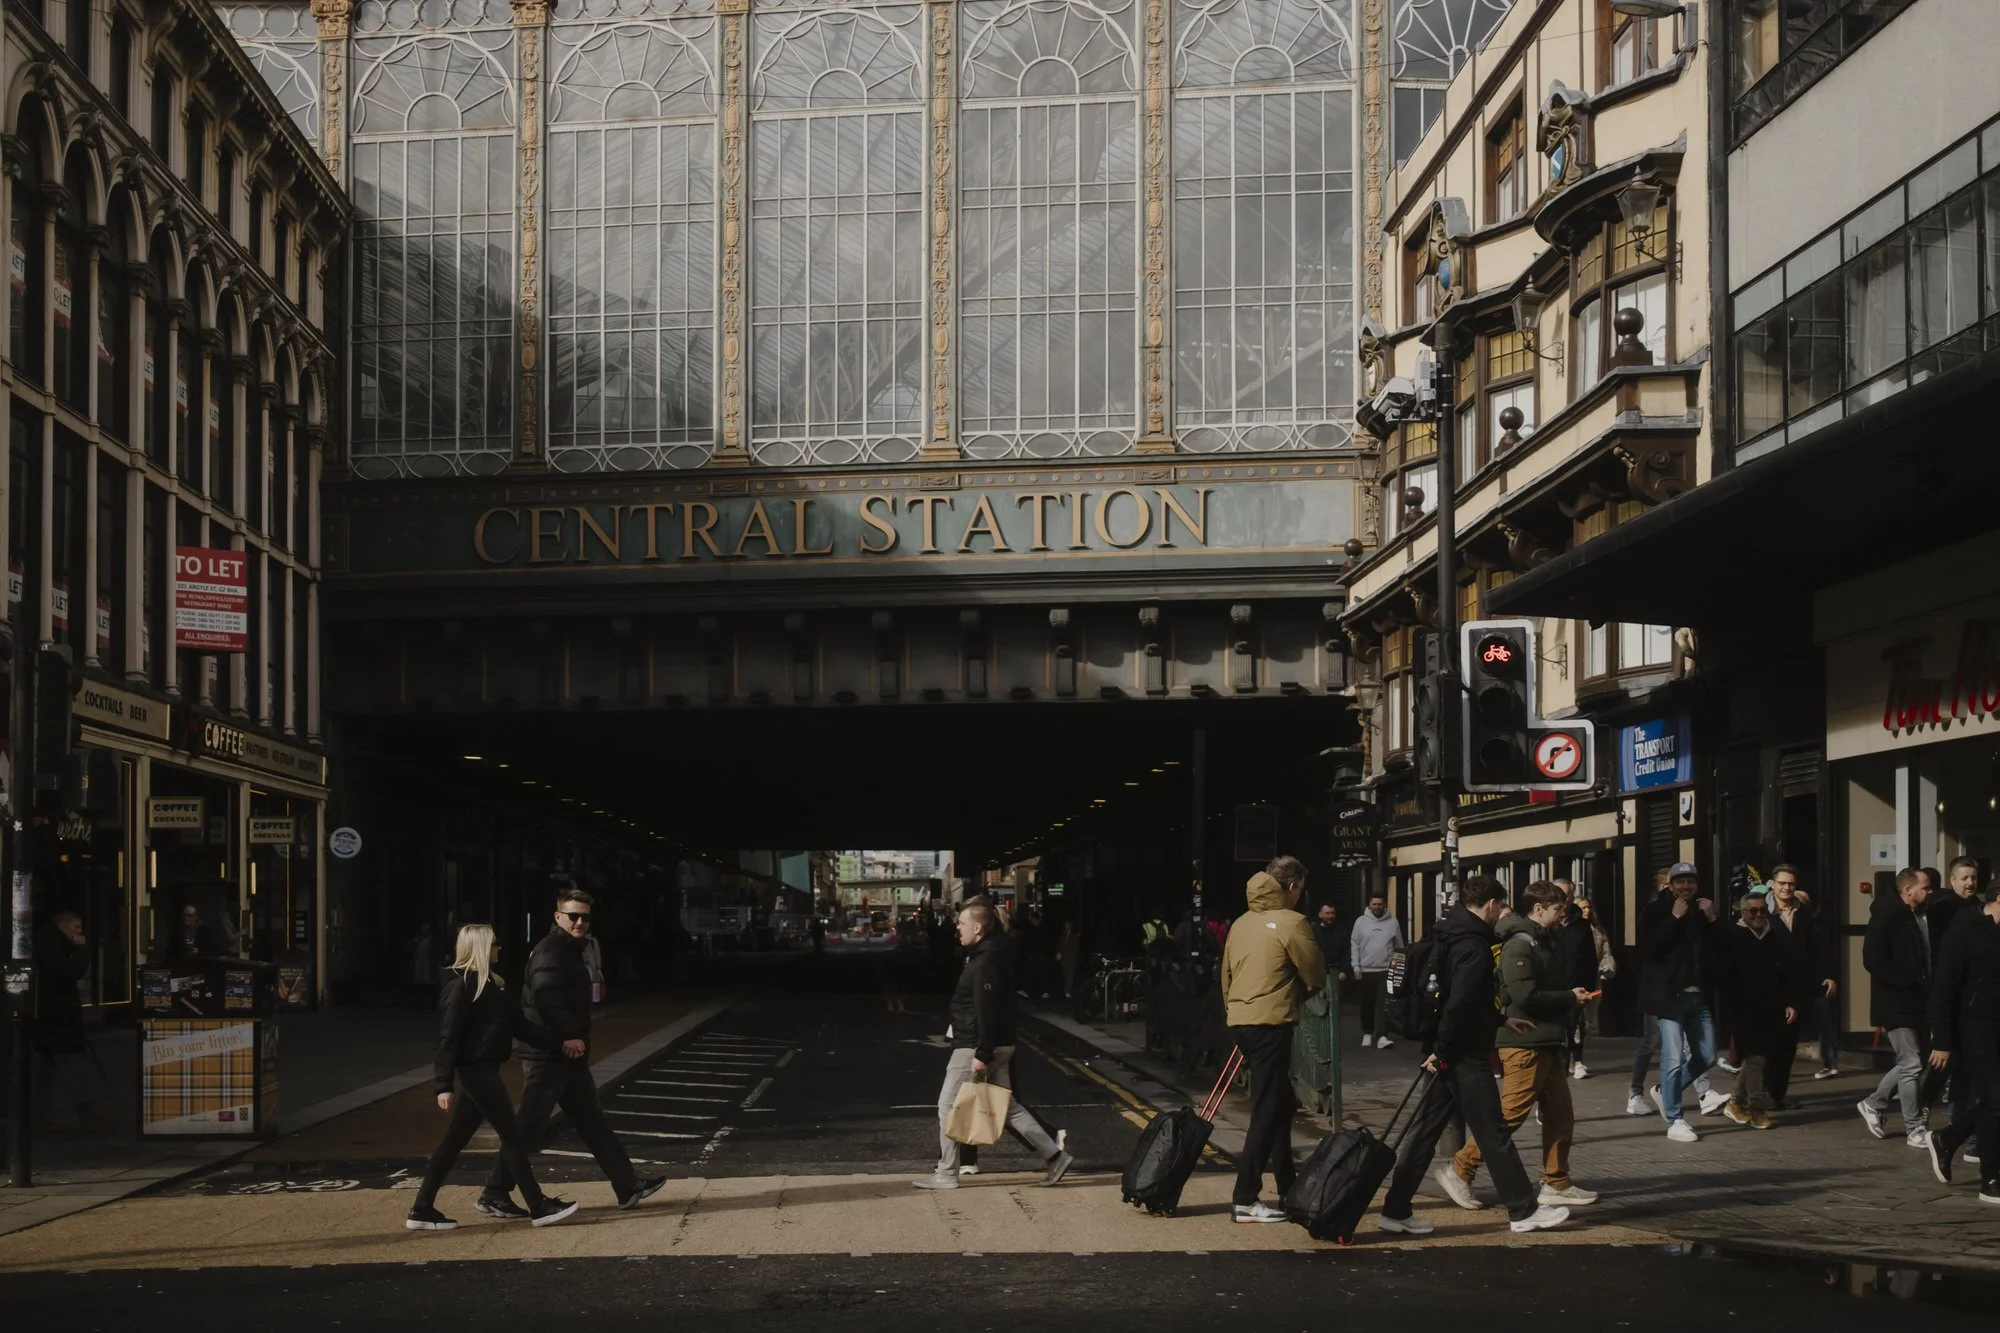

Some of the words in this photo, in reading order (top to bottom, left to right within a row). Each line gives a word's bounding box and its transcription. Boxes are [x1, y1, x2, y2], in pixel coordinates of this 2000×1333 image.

[473, 499, 835, 563] CENTRAL
[859, 487, 1214, 554] STATION
[175, 555, 202, 575] TO
[209, 558, 244, 579] LET
[84, 691, 122, 715] COCKTAILS
[130, 704, 147, 722] BEER
[203, 721, 245, 757] COFFEE
[1635, 726, 1646, 742] The
[1635, 735, 1675, 760] TRANSPORT
[1635, 758, 1655, 776] Credit
[1656, 757, 1676, 773] Union
[153, 803, 198, 812] COFFEE
[253, 821, 291, 830] COFFEE
[152, 1044, 174, 1062] Bin
[178, 1040, 206, 1057] your
[209, 1030, 246, 1049] litter!
